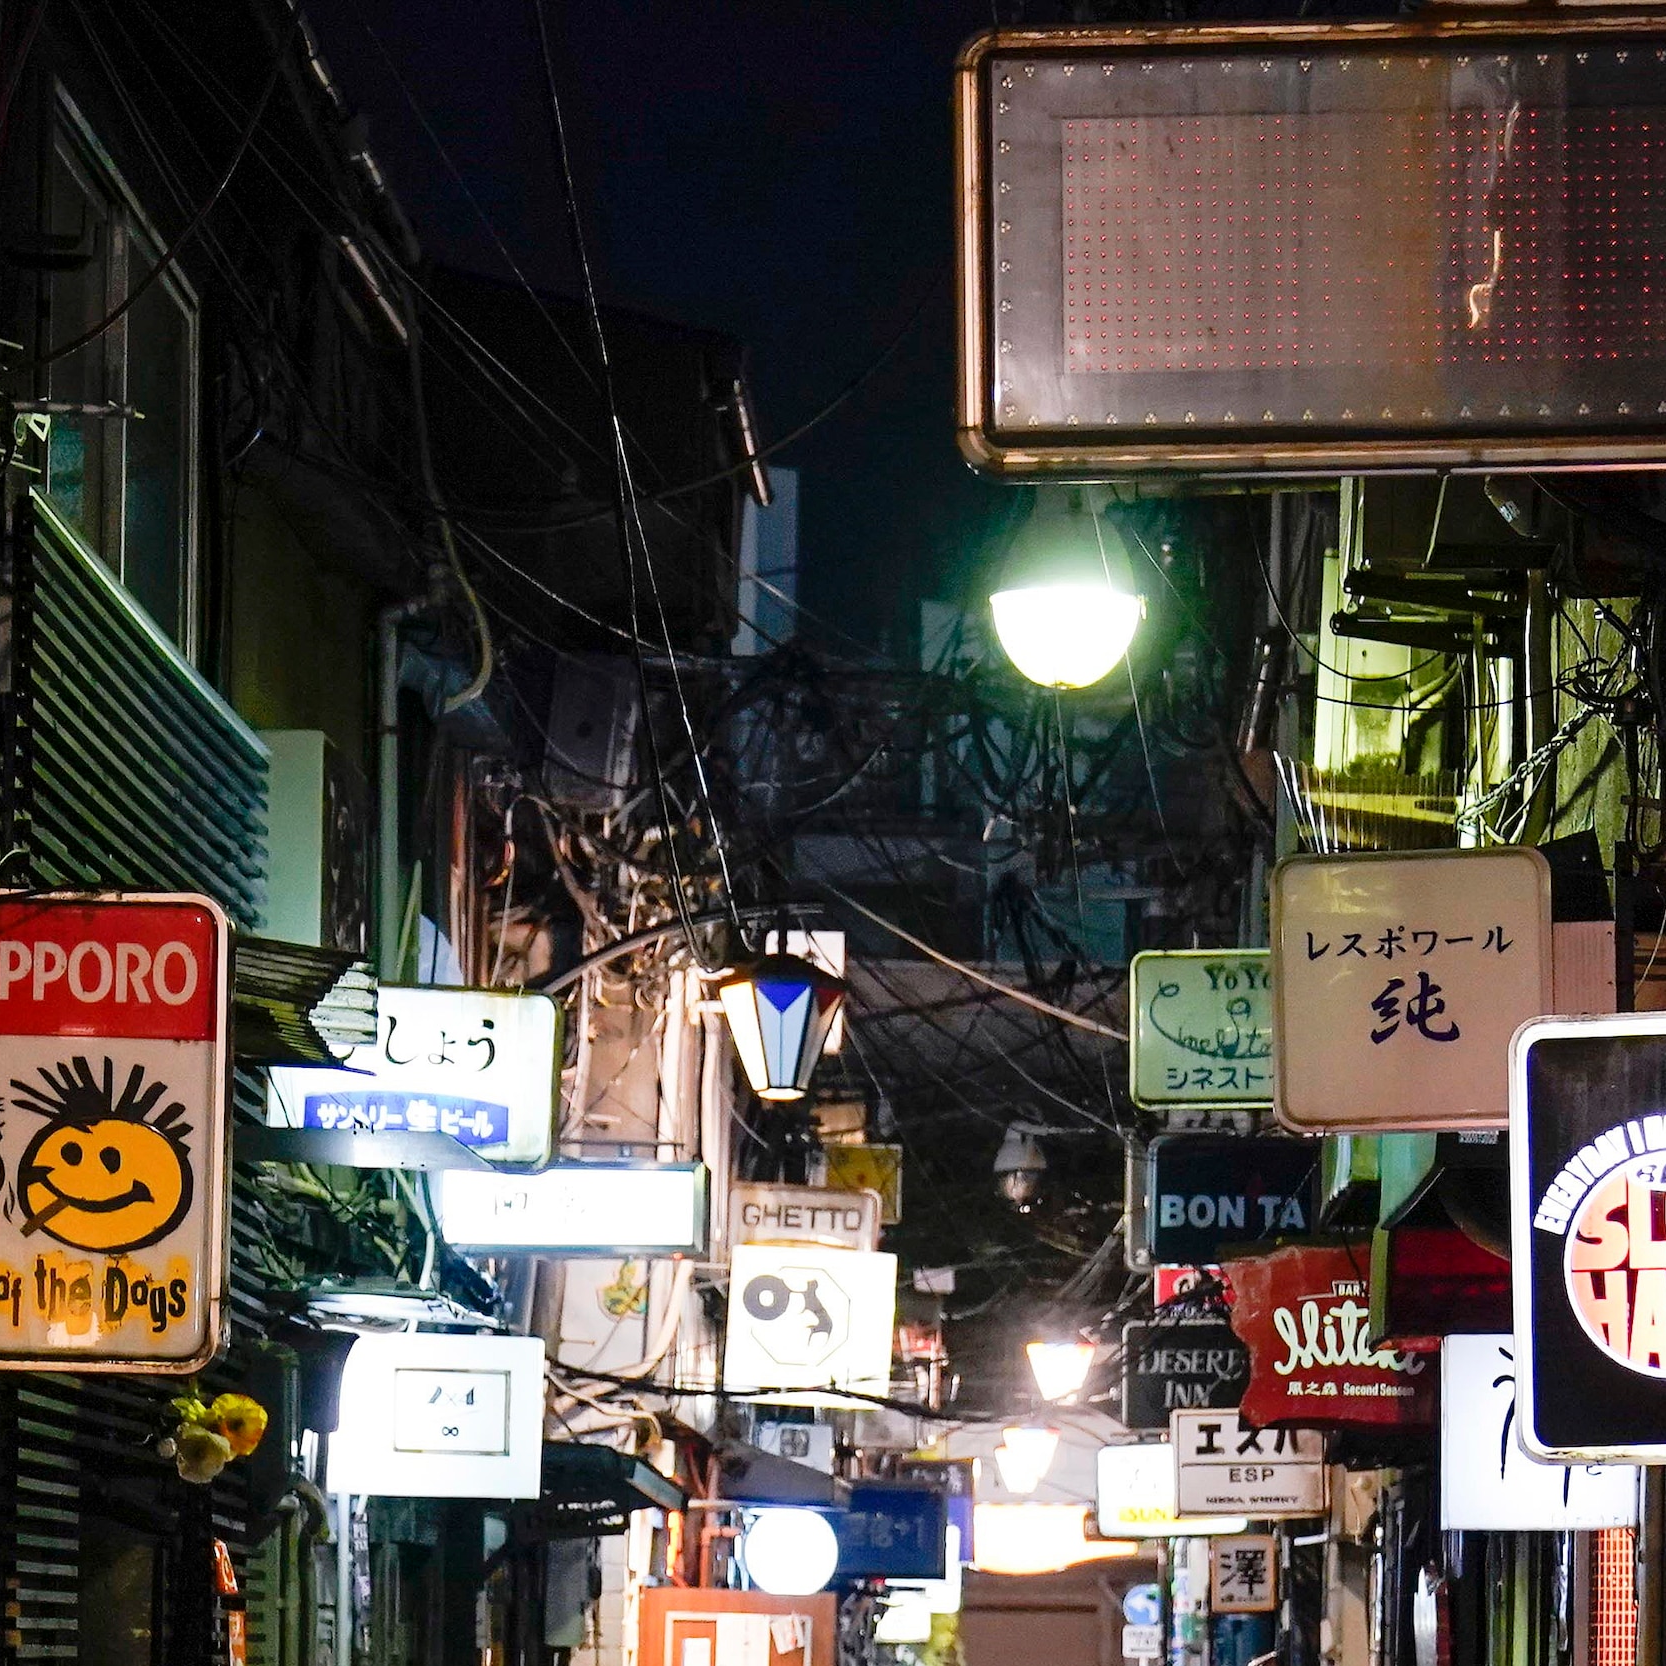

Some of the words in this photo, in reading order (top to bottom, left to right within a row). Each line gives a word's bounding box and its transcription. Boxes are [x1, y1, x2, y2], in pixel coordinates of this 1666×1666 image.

[1306, 925, 1514, 960] レスポワール
[1371, 971, 1461, 1045] 純
[1533, 1124, 1631, 1235] EVERYDAY
[1626, 1120, 1647, 1155] I
[742, 1203, 863, 1231] GHETTO
[1160, 1194, 1246, 1228] BON
[1257, 1195, 1306, 1229] TA
[34, 1258, 92, 1322] the
[103, 1265, 188, 1334] Dogs
[1343, 1382, 1379, 1396] Second
[1229, 1467, 1275, 1483] ESP
